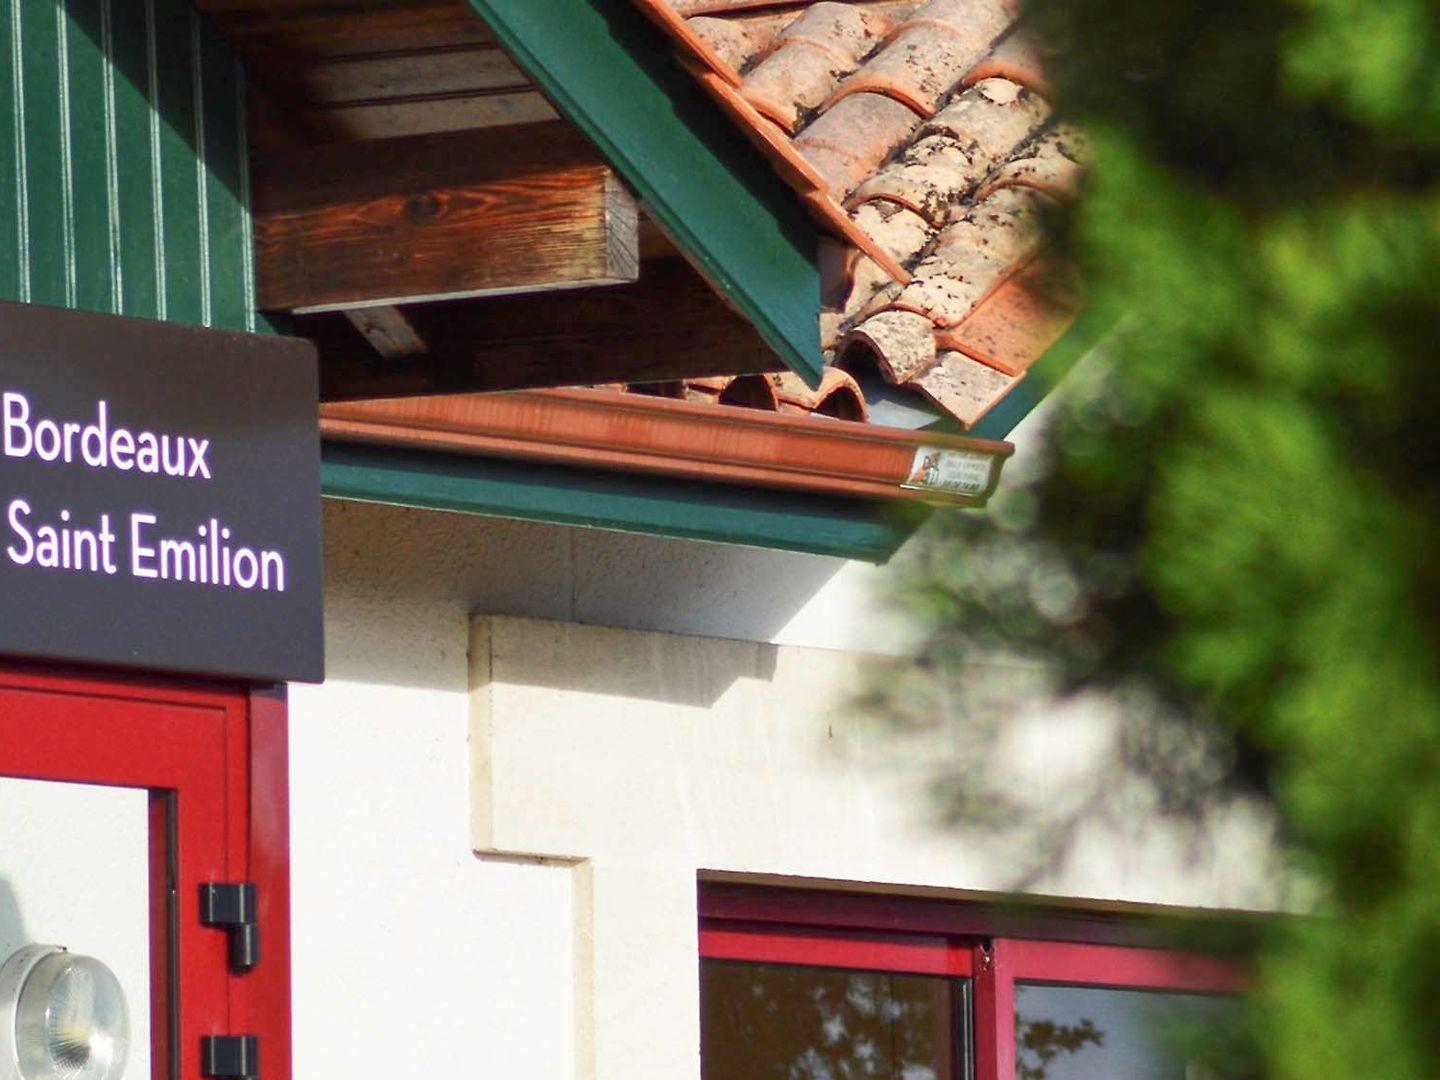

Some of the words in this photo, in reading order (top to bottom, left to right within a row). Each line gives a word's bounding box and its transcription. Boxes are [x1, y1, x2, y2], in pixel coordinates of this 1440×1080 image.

[2, 391, 212, 479] Bordeaux
[6, 499, 118, 575] Saint
[130, 512, 286, 592] Emilion
